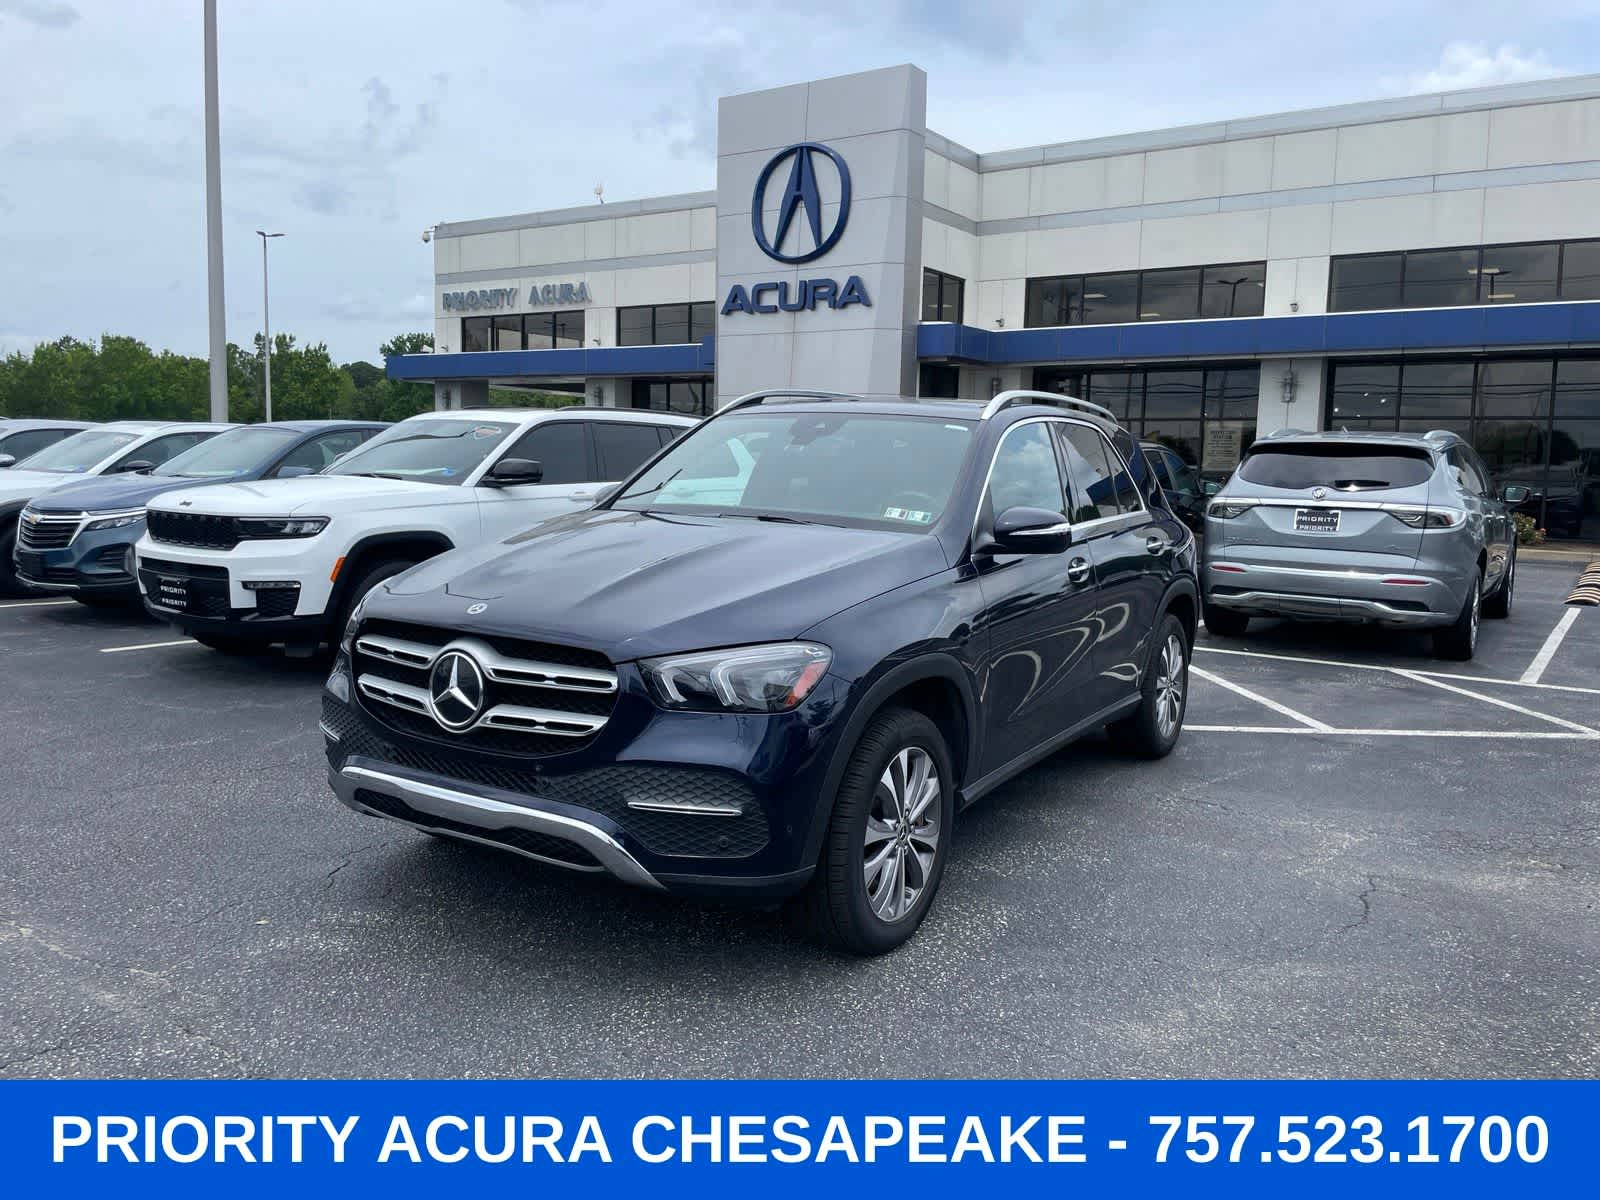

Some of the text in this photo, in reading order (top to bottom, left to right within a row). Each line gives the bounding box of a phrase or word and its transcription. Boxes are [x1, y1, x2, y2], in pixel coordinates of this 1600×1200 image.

[442, 281, 591, 312] PRIORITY ACURA
[720, 275, 873, 316] ACURA
[1296, 515, 1338, 523] PRIORITY
[160, 585, 187, 595] PRIORITY
[161, 597, 187, 608] PRIORITY
